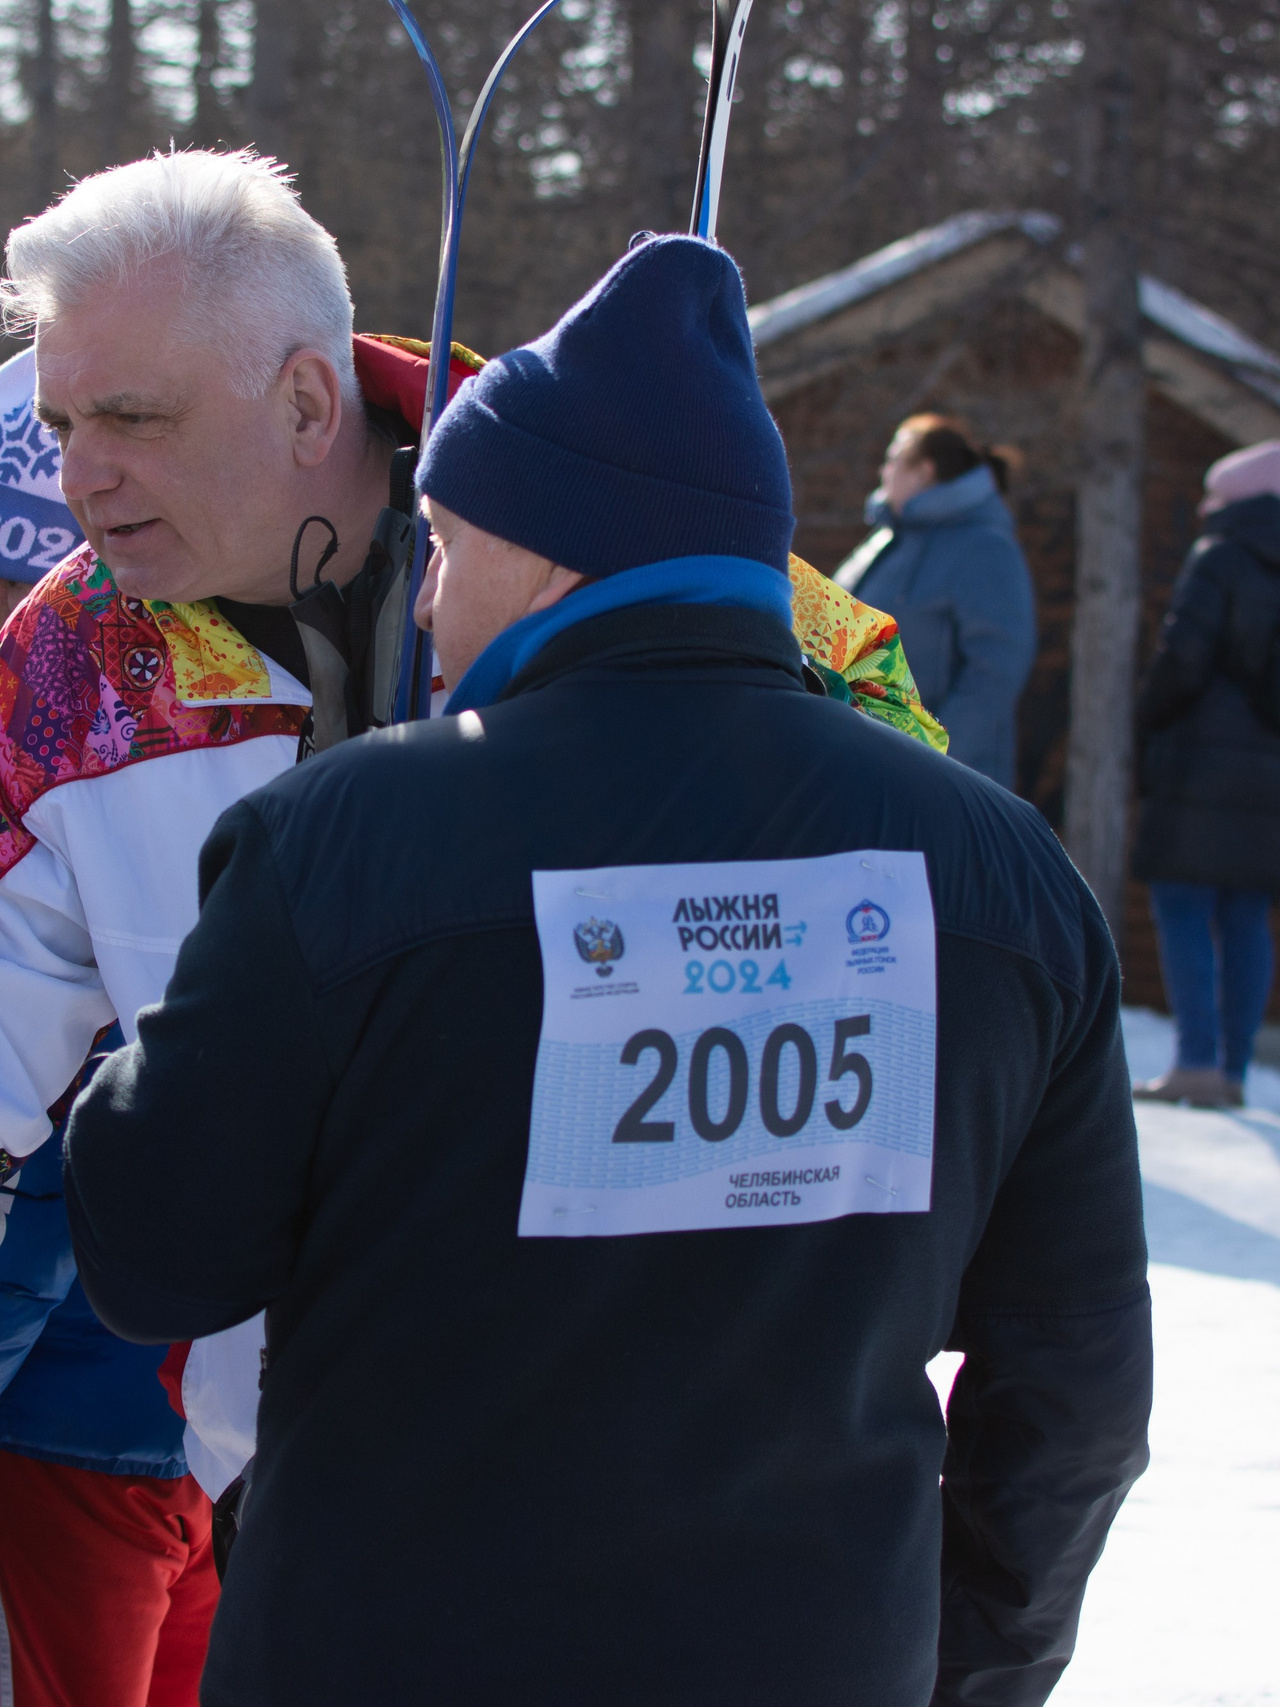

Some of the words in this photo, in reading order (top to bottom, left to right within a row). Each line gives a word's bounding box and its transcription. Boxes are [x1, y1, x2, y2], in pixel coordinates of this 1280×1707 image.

[672, 893, 780, 924] ЛЫЖНЯ
[677, 922, 783, 953] РОССИИ
[682, 958, 793, 995] 2024
[612, 1014, 873, 1144] 2005
[729, 1165, 841, 1189] ЧЕЛЯБИНСКАЯ
[725, 1190, 802, 1209] ОБЛАСТЬ
